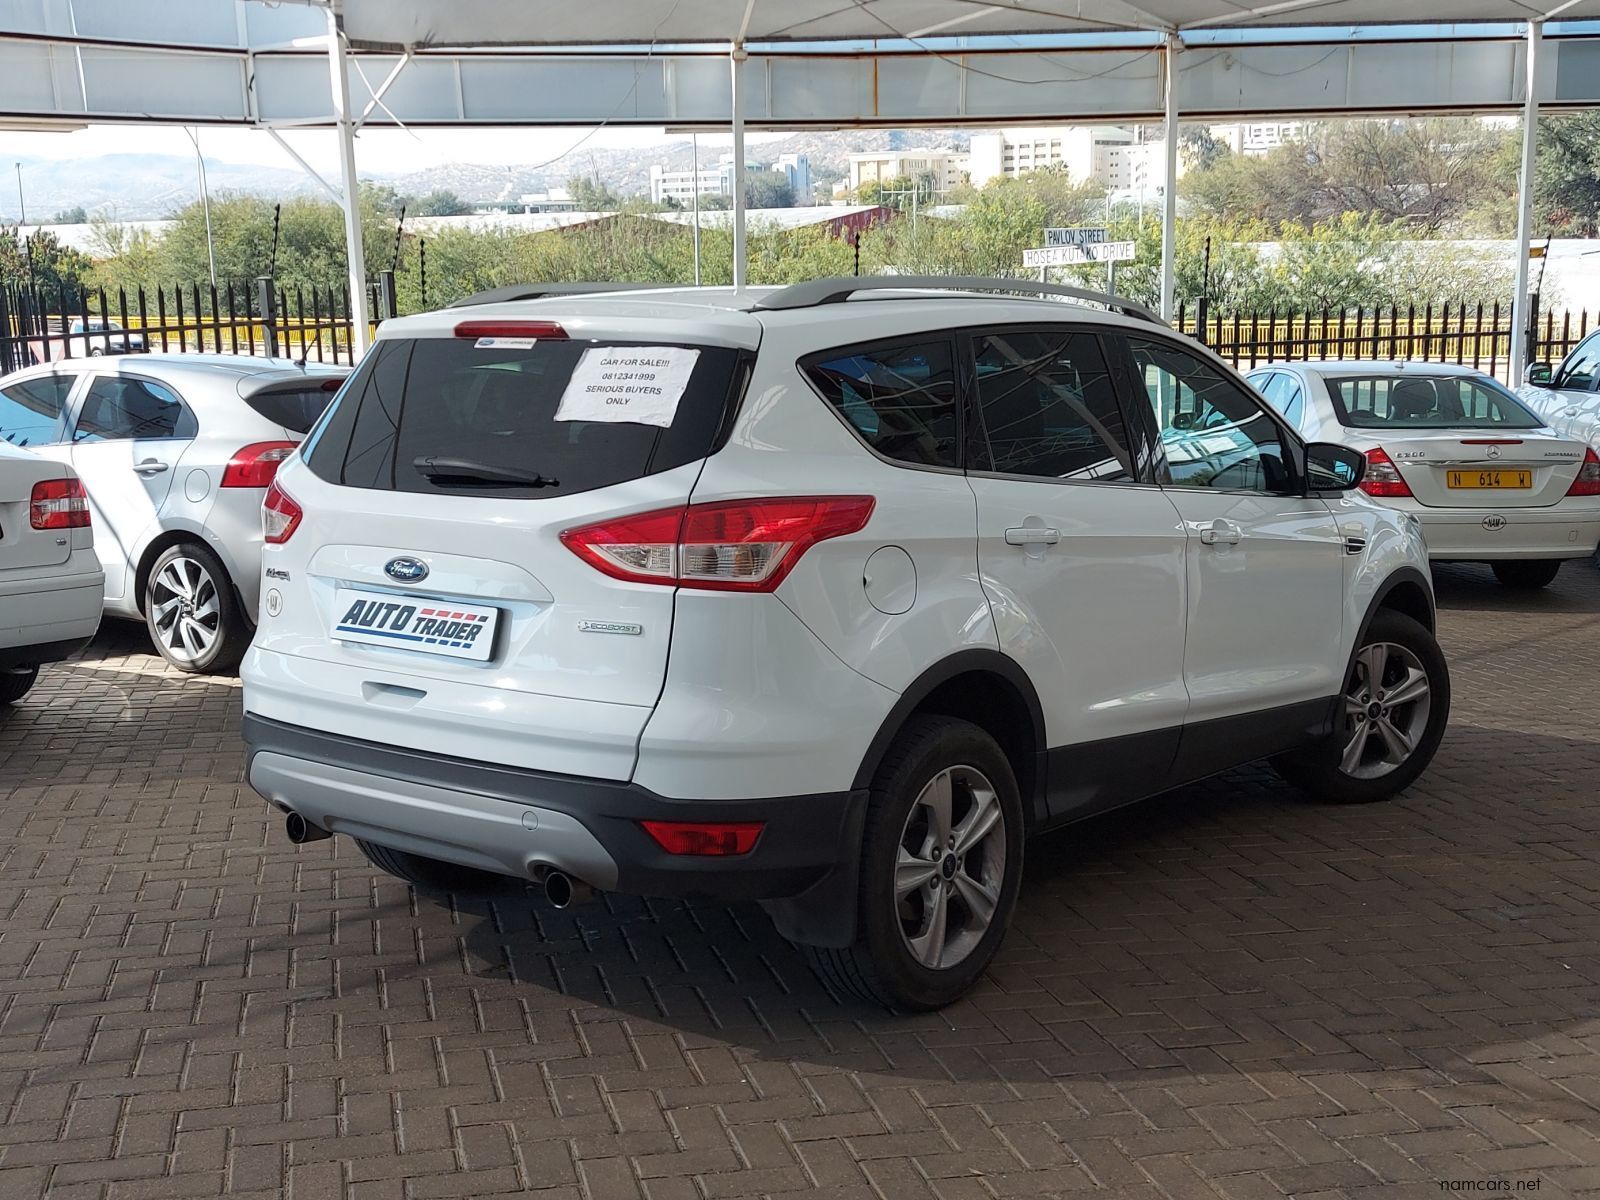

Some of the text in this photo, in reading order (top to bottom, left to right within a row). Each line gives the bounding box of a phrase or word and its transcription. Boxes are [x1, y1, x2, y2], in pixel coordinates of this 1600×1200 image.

[1048, 229, 1105, 245] PAVLOV STREET
[1027, 243, 1131, 265] HOSEA KUTAKO DRIVE
[600, 358, 670, 368] CAR FOR SALE!!!
[602, 372, 655, 381] 0812341999
[585, 385, 662, 395] SERIOUS BUYERS
[605, 397, 631, 405] ONLY
[1454, 472, 1525, 486] N 614 W
[340, 599, 483, 642] AUTO TRADER
